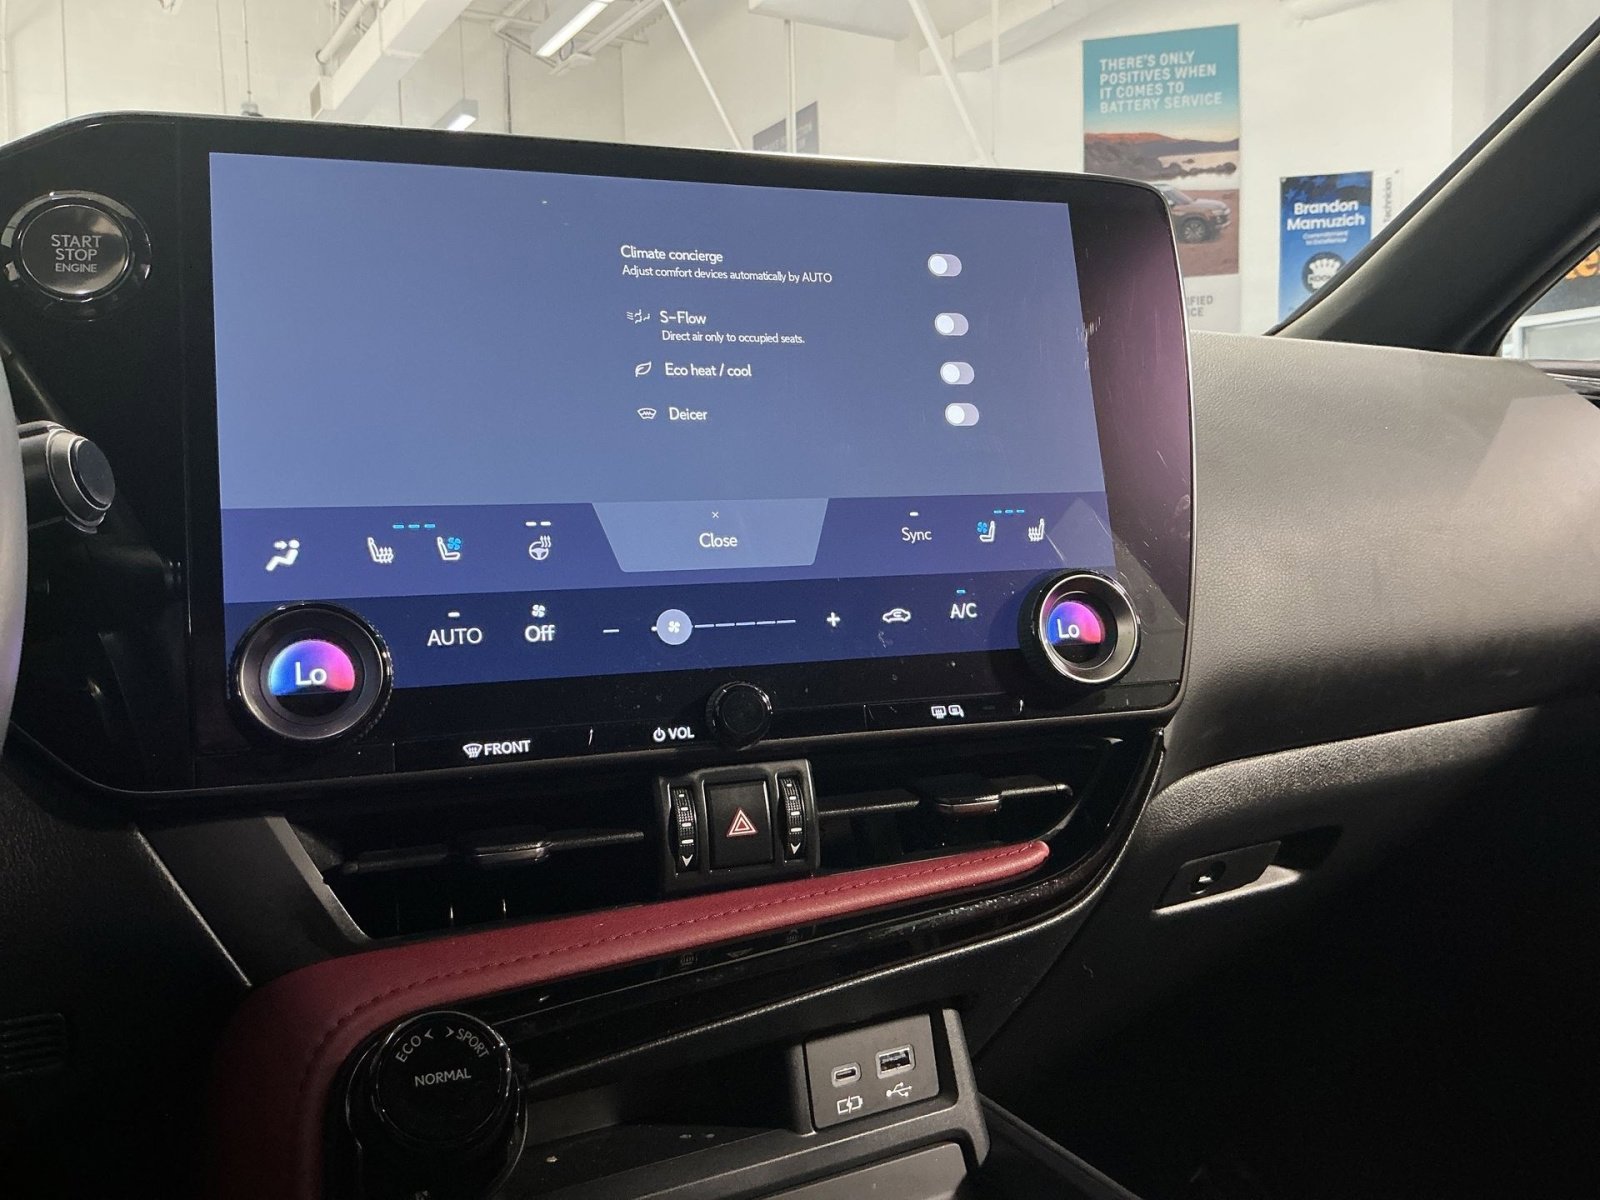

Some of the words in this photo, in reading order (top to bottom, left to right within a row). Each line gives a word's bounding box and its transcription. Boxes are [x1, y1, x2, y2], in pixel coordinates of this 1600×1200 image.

[1099, 54, 1156, 71] THERE'S
[1159, 50, 1195, 66] ONLY
[1099, 68, 1171, 86] POSITIVES
[1174, 63, 1217, 79] WHEN
[1099, 87, 1113, 100] IT
[1116, 83, 1163, 98] COMES
[1167, 81, 1185, 94] TO
[1100, 98, 1160, 114] BATTERY
[1163, 92, 1223, 109] SERVICE
[1294, 199, 1359, 215] Brandon
[1286, 214, 1366, 231] Mamuzich
[51, 234, 102, 248] START
[55, 248, 98, 261] STOP
[620, 244, 666, 259] Climate
[669, 250, 723, 264] concierge
[55, 262, 98, 273] ENGINE
[622, 265, 653, 279] Adjust
[655, 267, 692, 278] comfort
[694, 268, 728, 280] devices
[730, 270, 786, 283] automatically
[788, 272, 800, 284] by
[802, 272, 833, 283] AUTO
[659, 310, 707, 325] S-Flow
[662, 330, 690, 341] Direct
[692, 331, 703, 342] air
[705, 332, 724, 344] only
[726, 333, 736, 343] to
[738, 333, 778, 345] occupied
[780, 334, 805, 344] seats.
[664, 362, 688, 376] Eco
[690, 363, 716, 376] heat
[727, 364, 752, 377] cool
[668, 406, 707, 420] Deicer
[699, 532, 738, 549] Close
[901, 527, 933, 543] Sync
[950, 602, 978, 619] A/C
[427, 627, 483, 647] AUTO
[524, 624, 556, 642] Off
[1056, 617, 1081, 641] Lo
[294, 661, 327, 686] Lo
[667, 726, 695, 740] VOL
[484, 739, 531, 756] FRONT
[395, 1035, 422, 1062] ECO
[455, 1028, 490, 1058] SPORT
[414, 1067, 472, 1088] NORMAL
